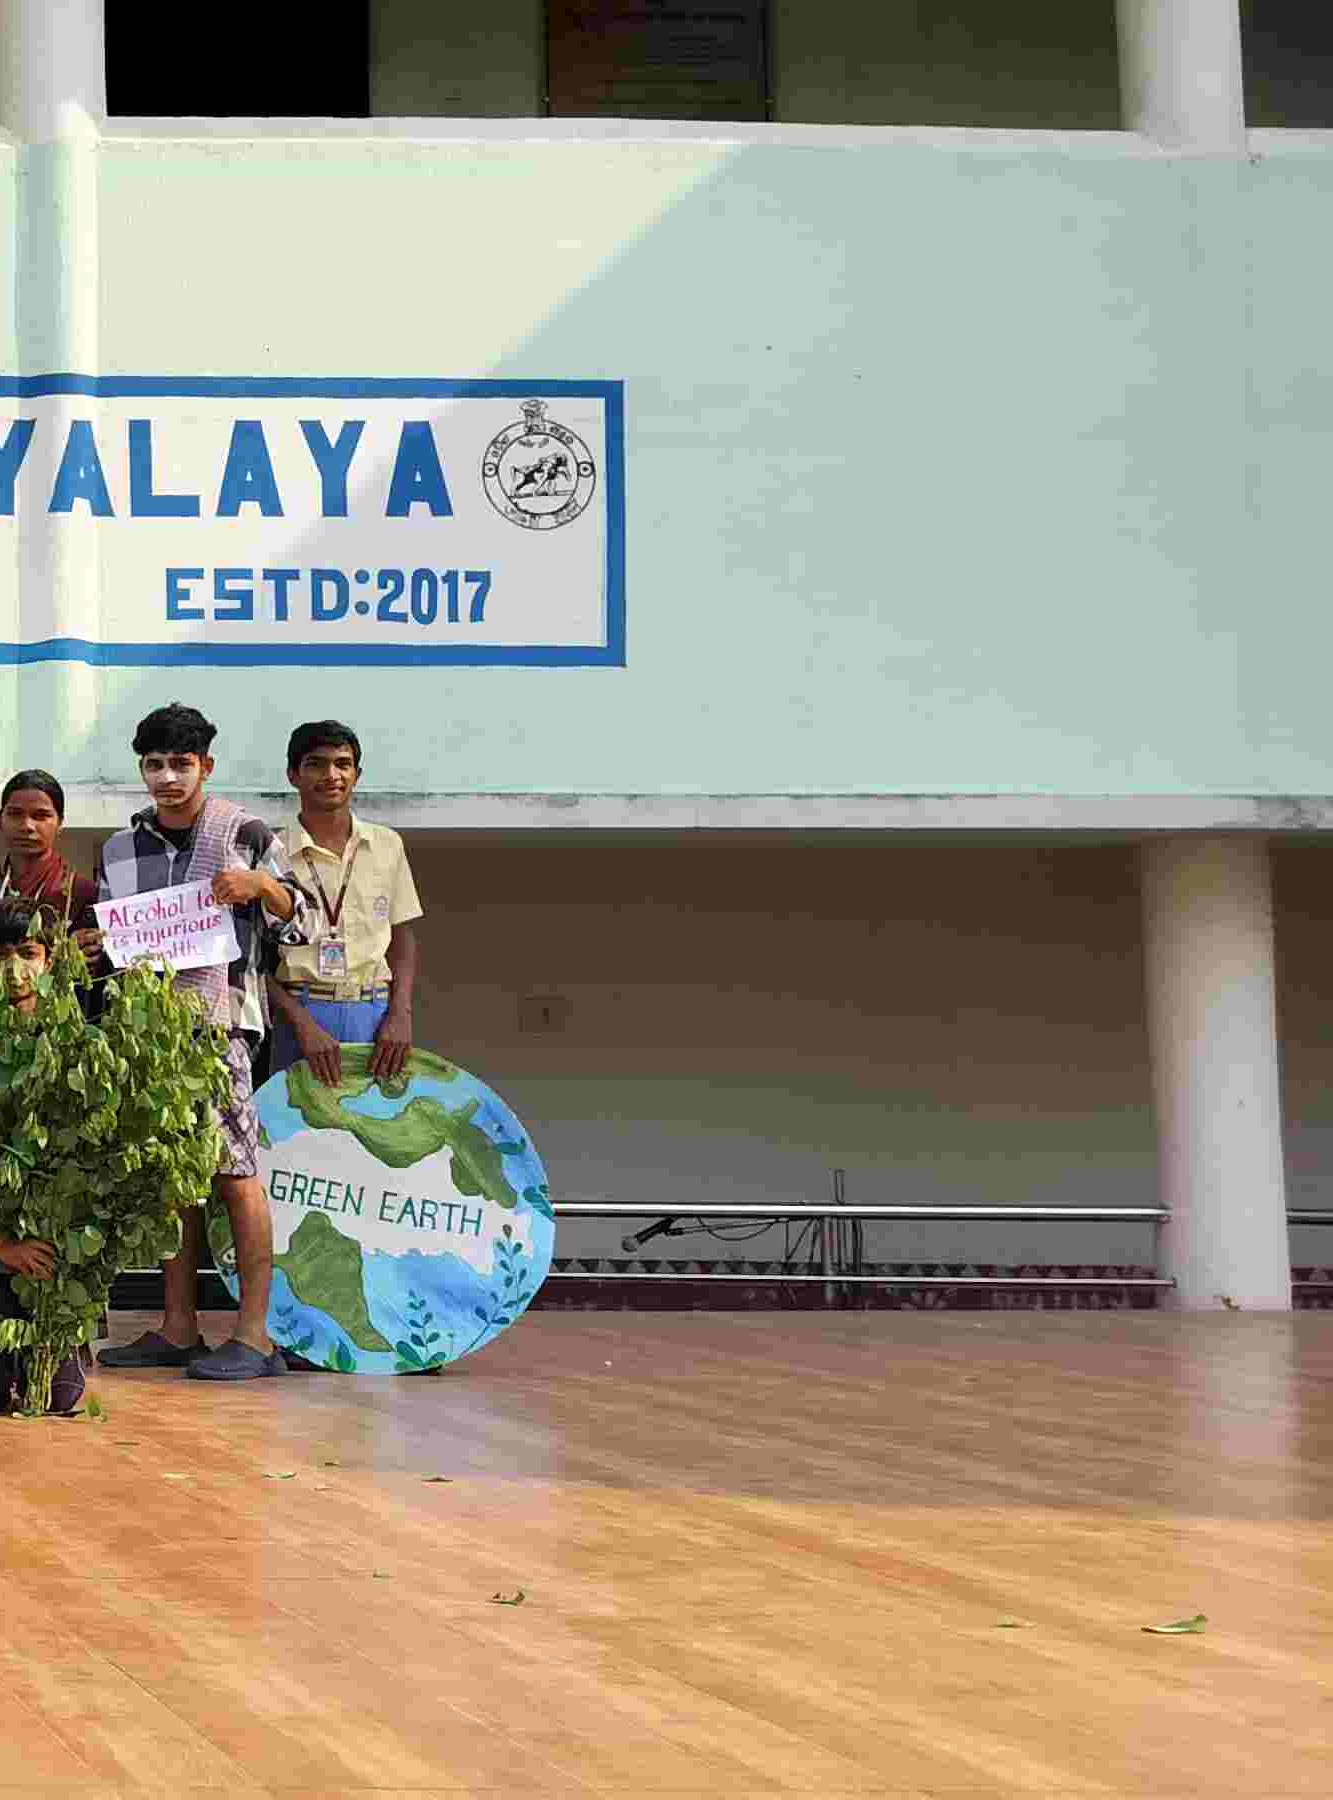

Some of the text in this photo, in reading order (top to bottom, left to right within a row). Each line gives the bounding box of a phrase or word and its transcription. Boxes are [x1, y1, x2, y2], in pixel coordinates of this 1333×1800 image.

[165, 567, 492, 625] ESTD:2017
[108, 892, 184, 929] Alcohol
[136, 914, 222, 948] injurious
[269, 1168, 483, 1237] GREEN EARTH
